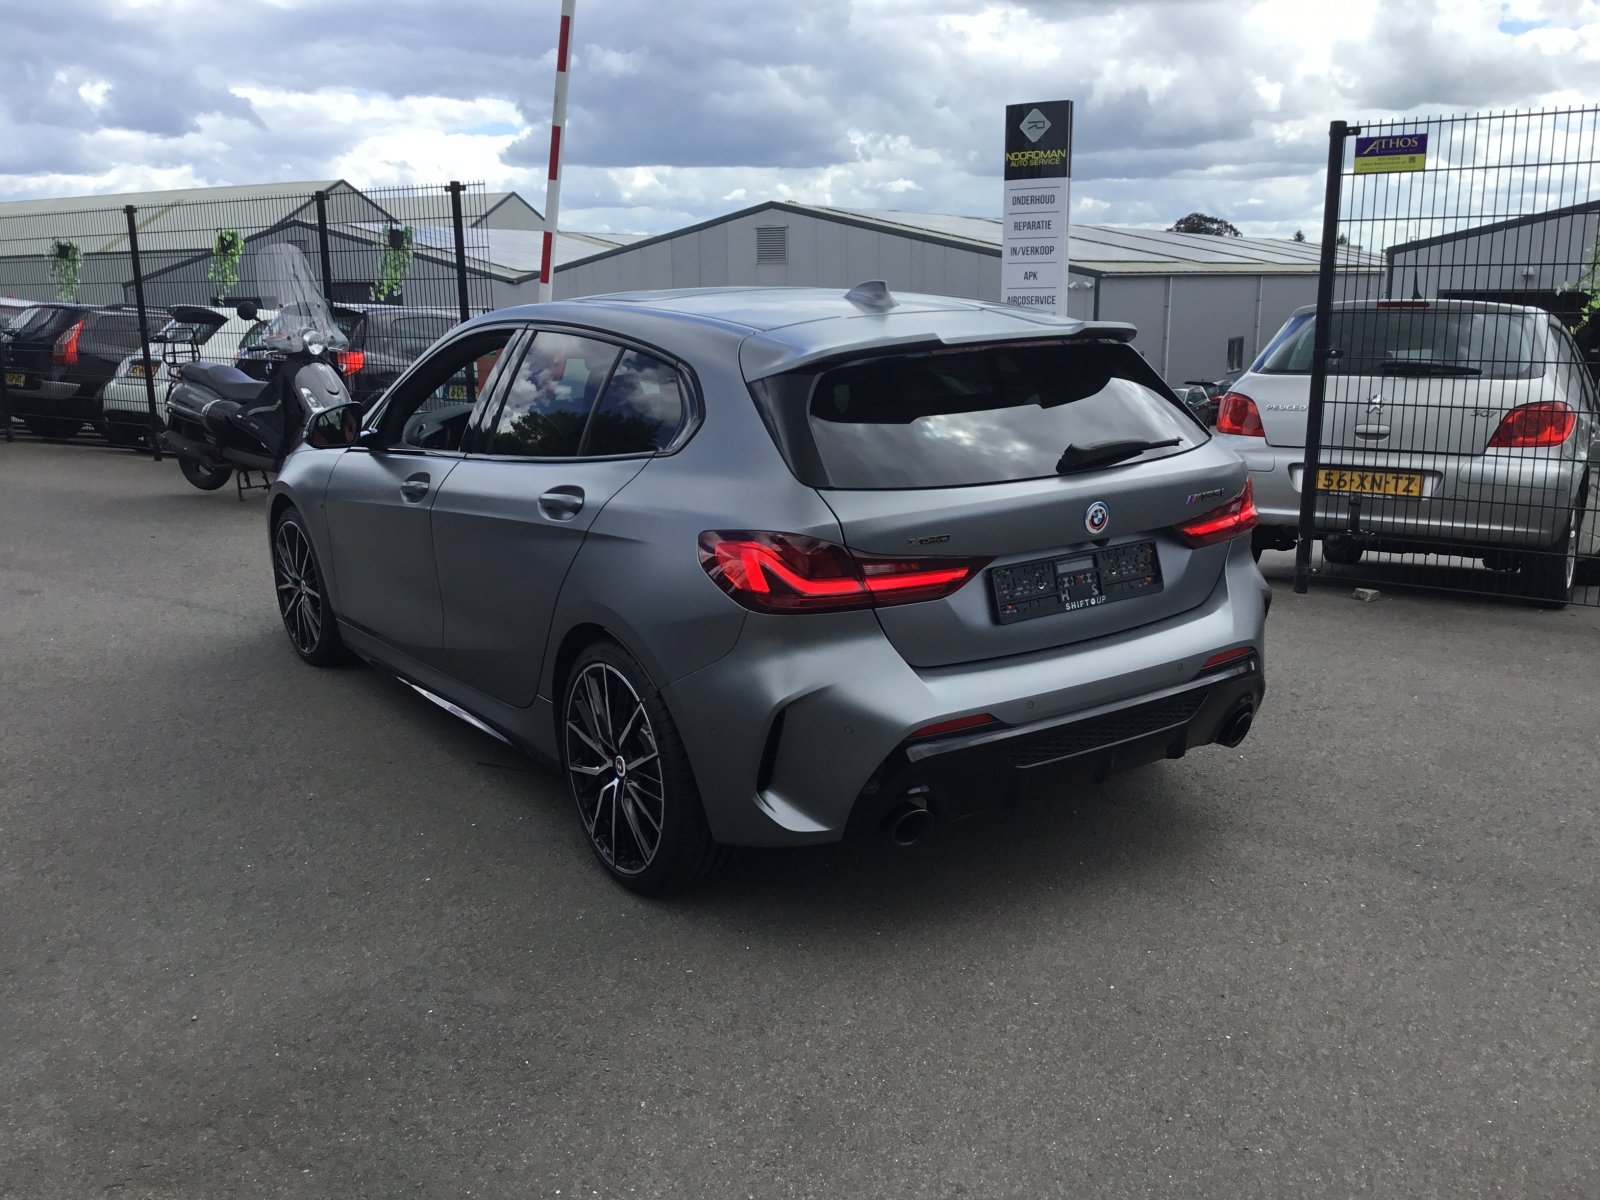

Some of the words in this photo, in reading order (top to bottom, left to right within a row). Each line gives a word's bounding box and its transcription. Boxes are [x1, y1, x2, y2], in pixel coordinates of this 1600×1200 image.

[1361, 136, 1418, 155] ATHOS
[1006, 149, 1066, 161] NOORDMAN
[1010, 159, 1028, 167] AUTO
[1029, 157, 1061, 166] SERVICE
[1012, 194, 1055, 206] ONDERHOUD
[1013, 219, 1052, 231] REPARATIE
[1010, 245, 1054, 256] IN/VERKOOP
[1023, 270, 1038, 281] APK
[1006, 295, 1056, 306] AIRCOSERVICE
[1265, 404, 1308, 412] PEUGEO
[1322, 471, 1416, 494] 56-XN-TZ
